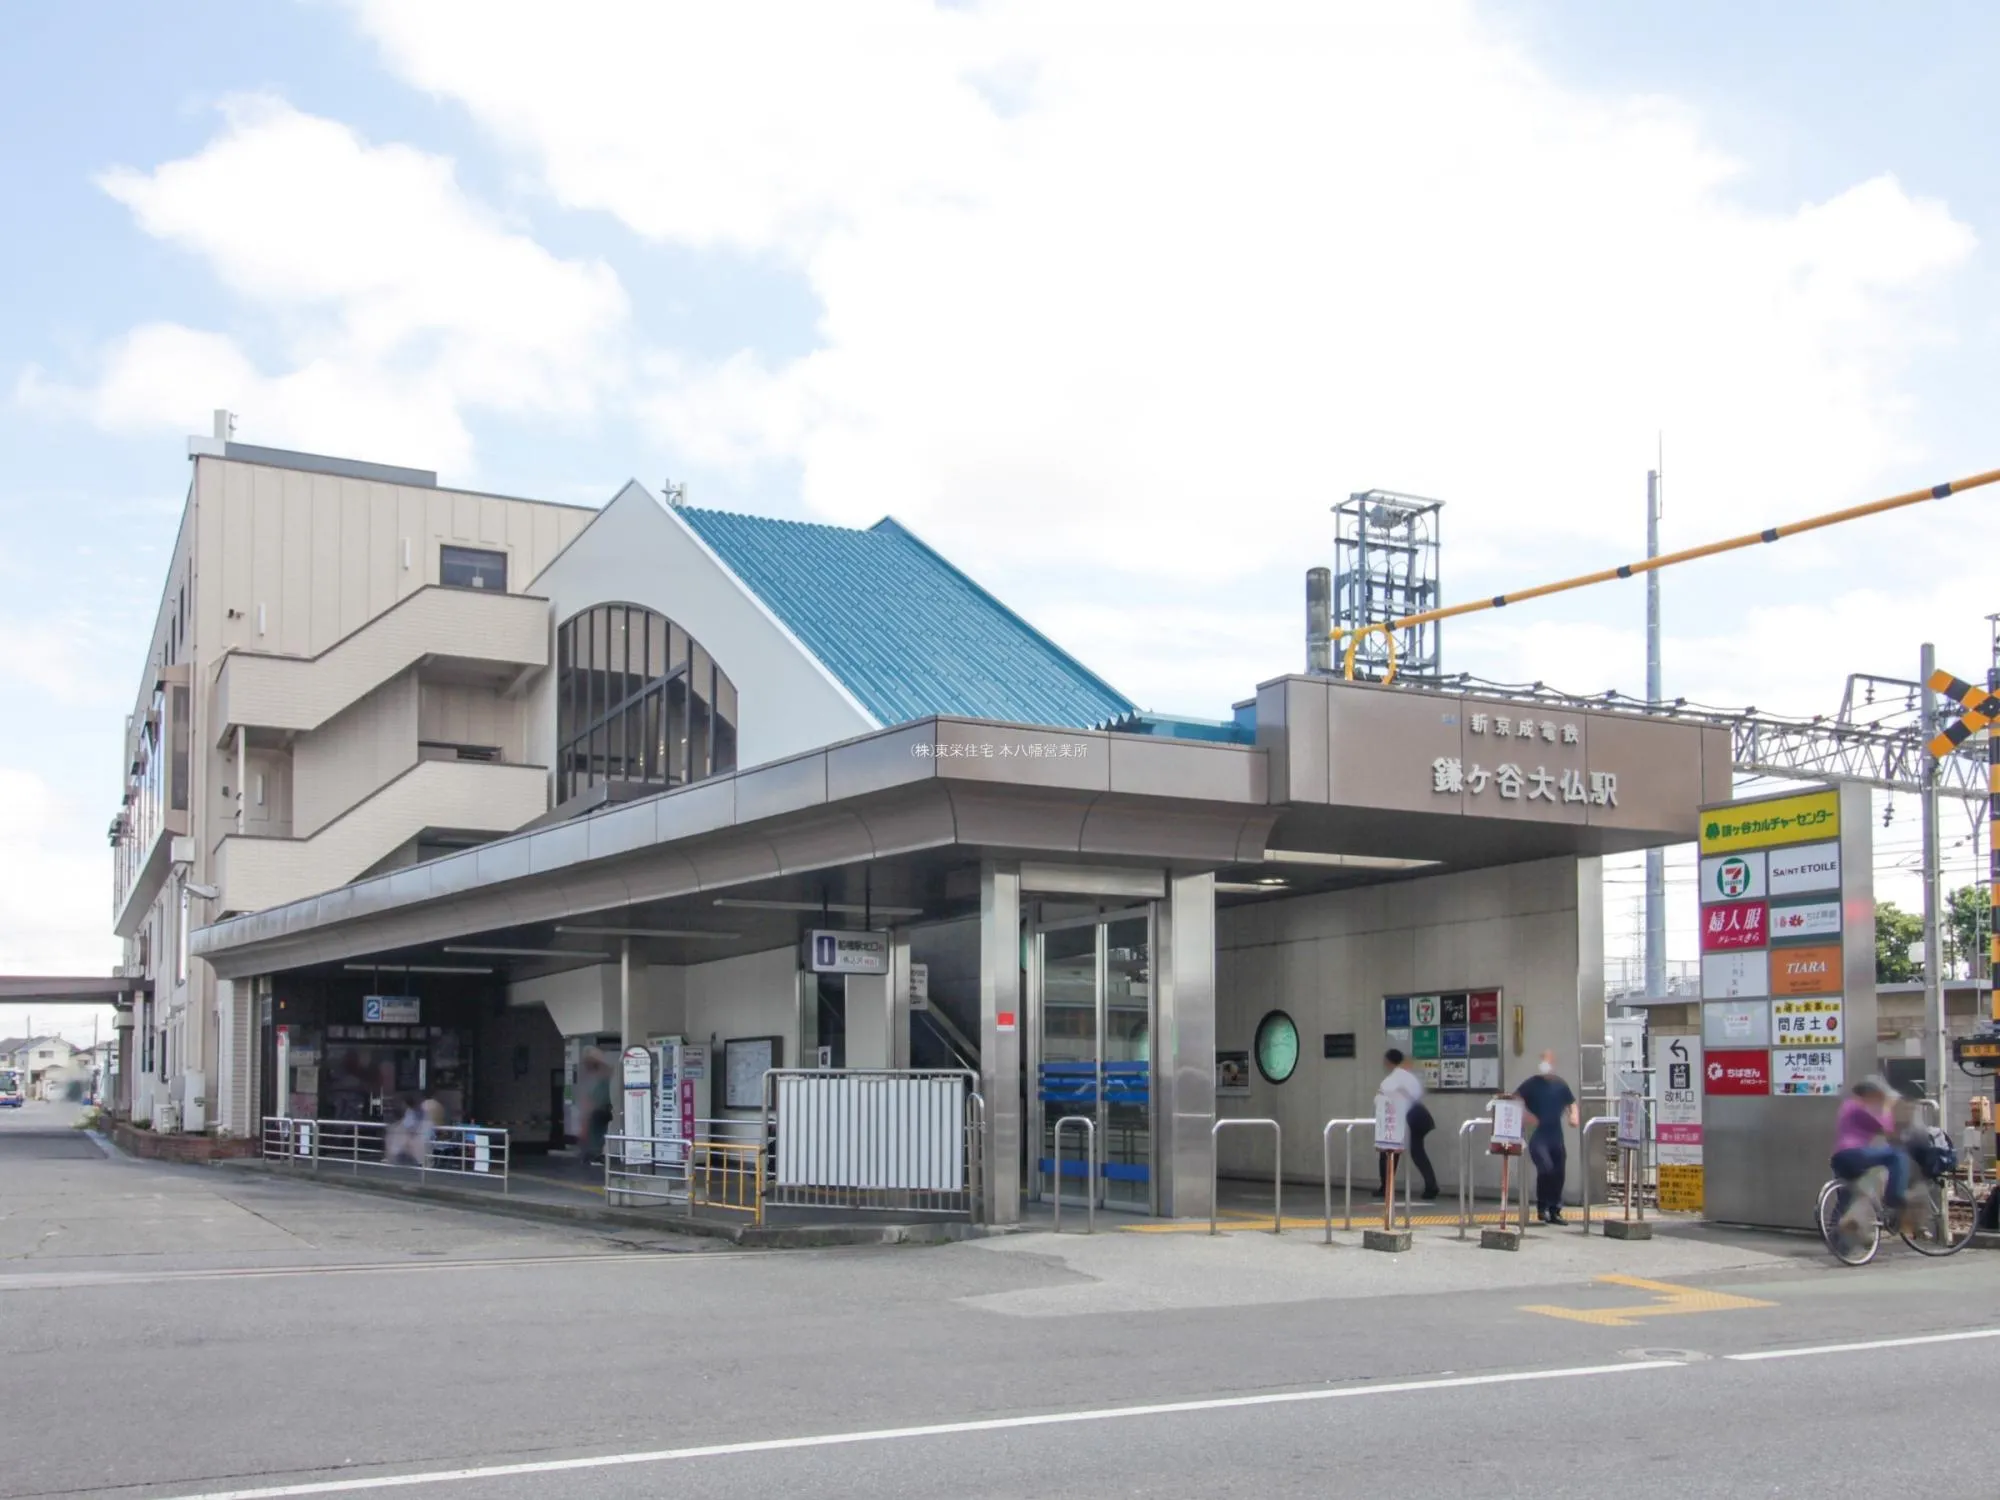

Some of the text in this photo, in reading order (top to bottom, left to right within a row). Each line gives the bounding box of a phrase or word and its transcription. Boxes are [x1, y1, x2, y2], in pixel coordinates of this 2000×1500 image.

[1471, 713, 1579, 743] 新京成電鉄
[1800, 861, 1836, 874] ETOILE
[1708, 907, 1761, 932] 婦人服
[1785, 961, 1827, 974] TIARA
[368, 1002, 379, 1017] 2
[1784, 1052, 1832, 1066] 大門歯科
[1727, 1068, 1761, 1078] ちばぎん
[1665, 1090, 1695, 1103] 改札口
